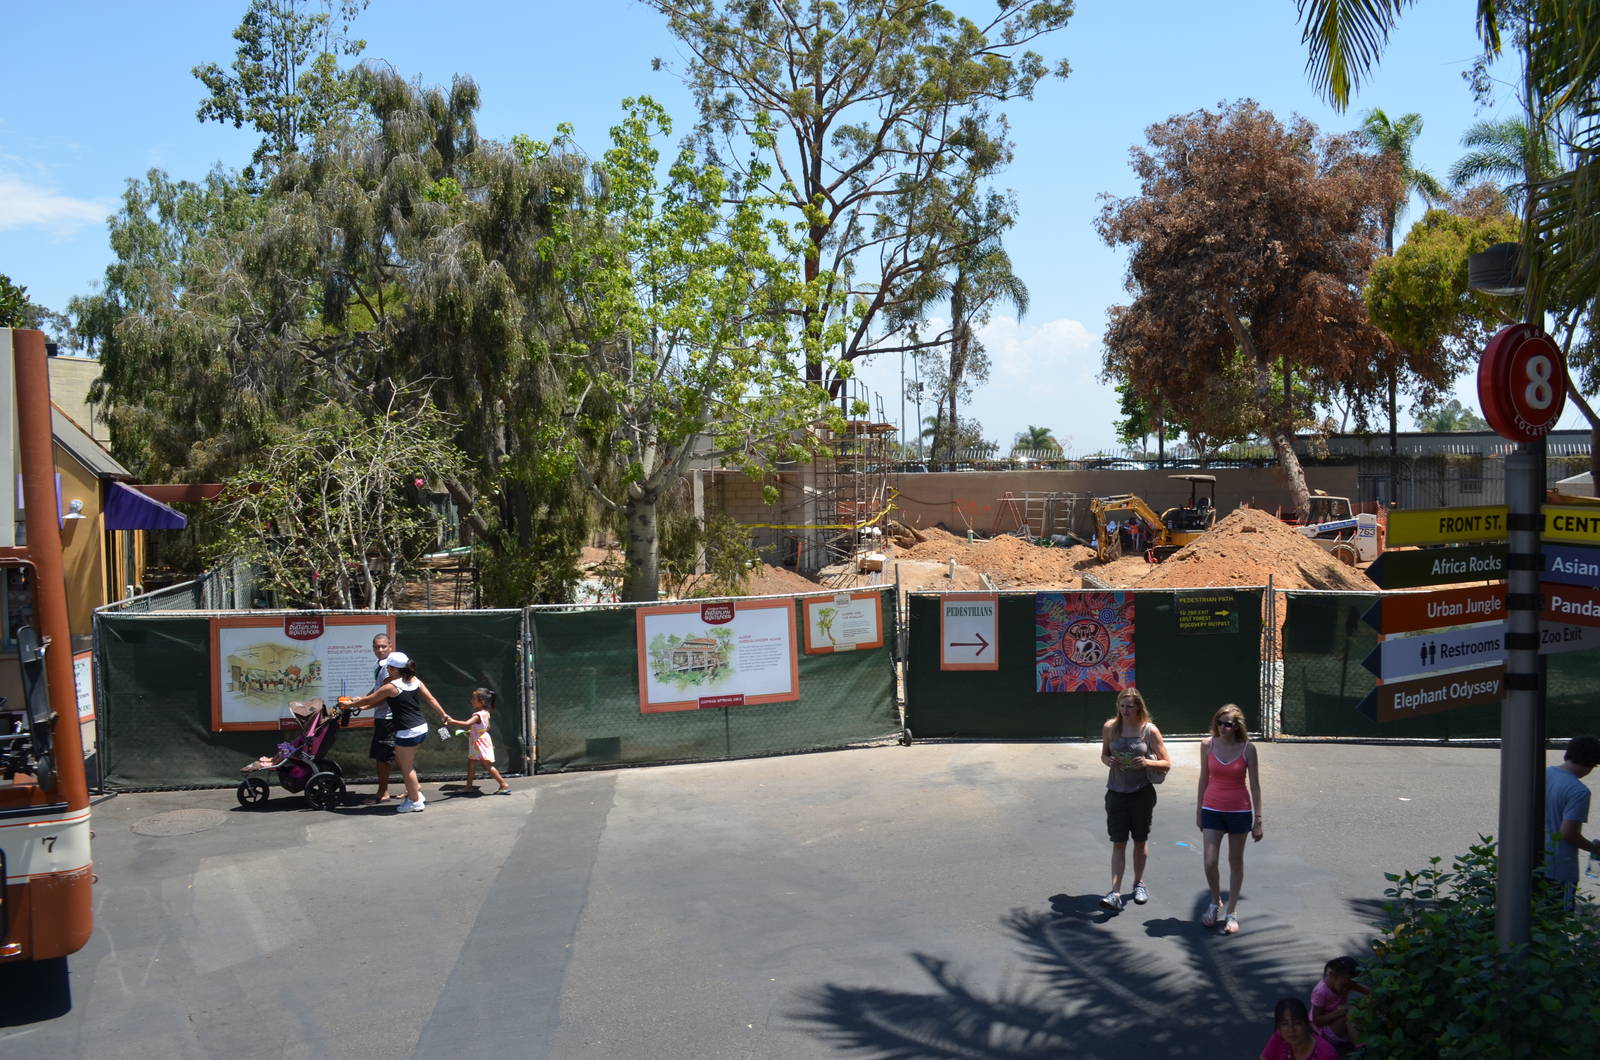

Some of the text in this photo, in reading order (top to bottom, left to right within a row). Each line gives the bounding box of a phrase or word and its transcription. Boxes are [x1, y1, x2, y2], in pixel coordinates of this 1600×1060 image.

[1524, 354, 1553, 410] 8
[1514, 414, 1560, 436] LOCATION
[1439, 514, 1502, 533] FRONT ST.
[1431, 556, 1502, 576] Africa Rocks
[1551, 557, 1599, 577] Asian
[946, 606, 993, 617] PEDESTRIANS
[1427, 595, 1501, 618] Urban Jungle
[1551, 596, 1600, 617] Panda
[1541, 628, 1582, 645] Zoo Exit
[1440, 638, 1500, 659] Restrooms
[1394, 679, 1500, 709] Elephant Odyssey
[42, 836, 58, 853] 7
